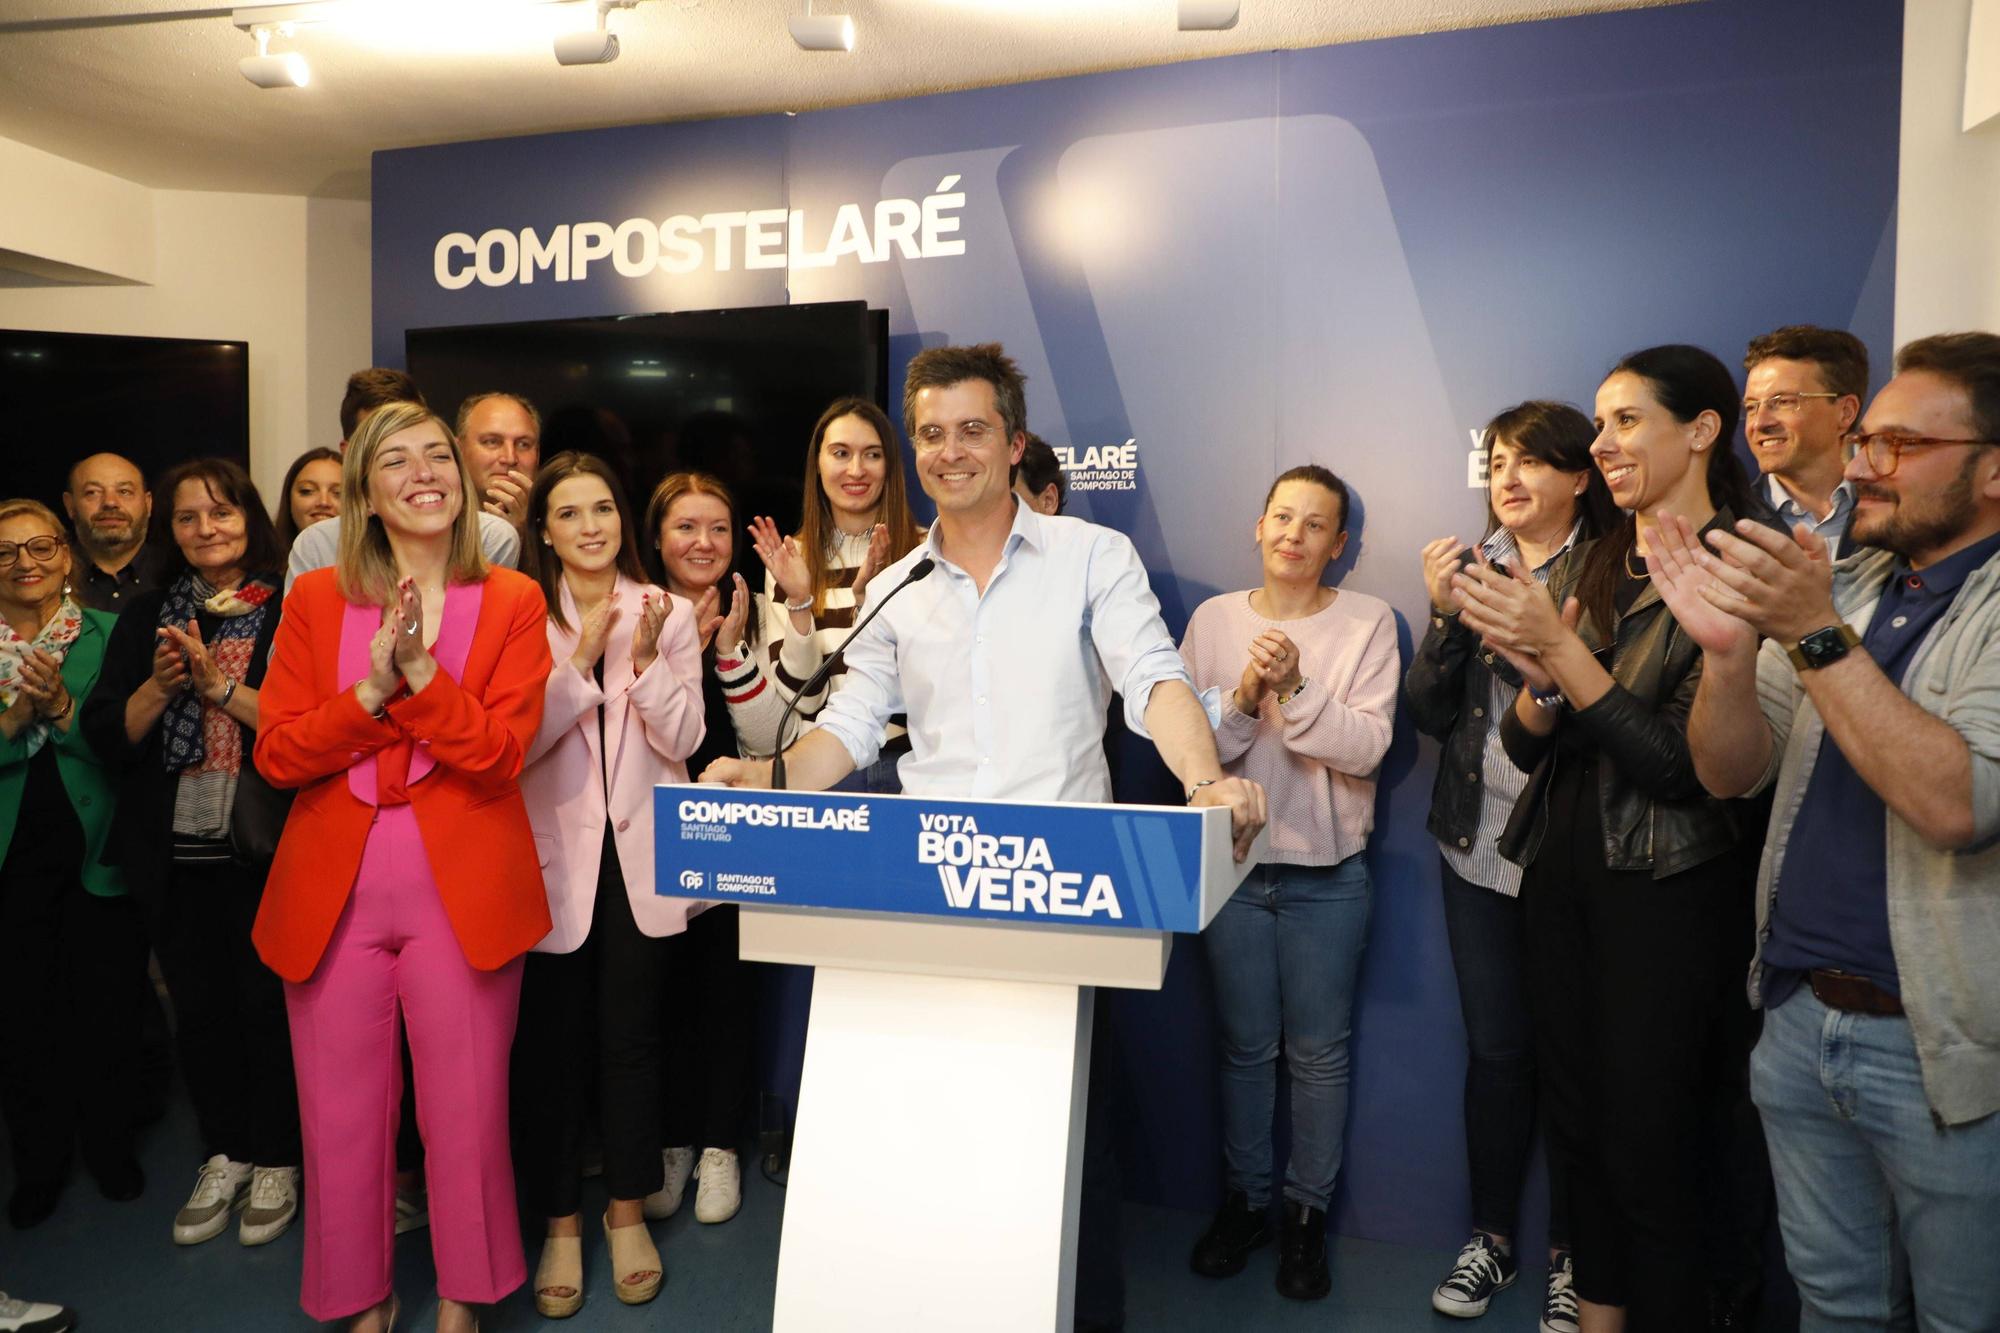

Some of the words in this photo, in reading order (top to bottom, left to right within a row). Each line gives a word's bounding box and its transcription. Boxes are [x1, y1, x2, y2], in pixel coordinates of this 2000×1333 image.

[434, 174, 966, 290] COMPOSTELARÉ
[1070, 470, 1120, 481] SANTIAGO
[1121, 470, 1135, 480] DE
[1070, 480, 1137, 491] COMPOSTELA
[678, 800, 870, 832] COMPOSTELARÉ
[680, 822, 727, 834] SANTIAGO
[919, 813, 978, 834] VOTA
[680, 831, 694, 840] EN
[695, 832, 732, 842] FUTURO
[918, 831, 1054, 871] BORJA
[716, 873, 761, 885] SANTIAGO
[762, 876, 775, 886] DE
[716, 883, 777, 895] COMPOSTELA
[937, 865, 1123, 919] VEREA
